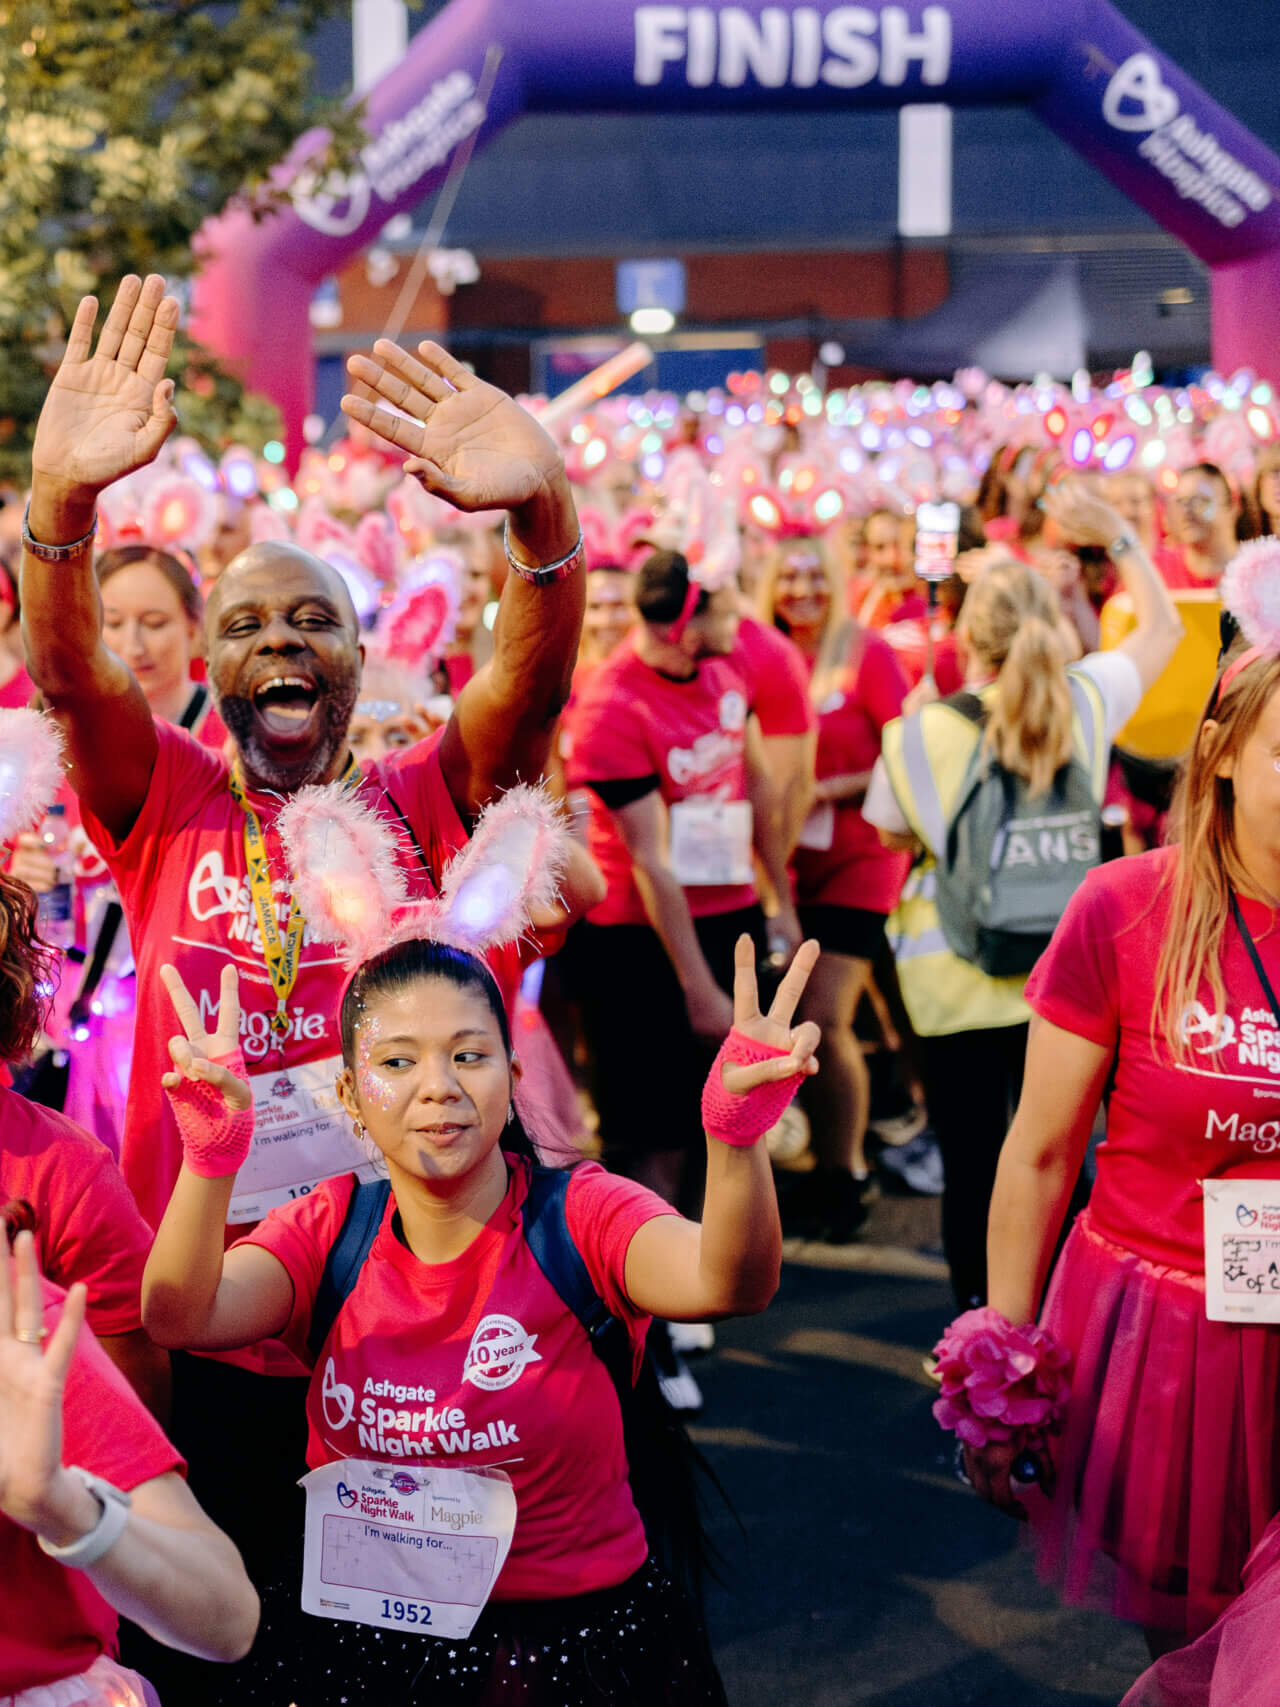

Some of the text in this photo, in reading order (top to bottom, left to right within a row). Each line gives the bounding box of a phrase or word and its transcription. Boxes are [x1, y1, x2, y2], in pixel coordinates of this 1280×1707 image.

[634, 6, 951, 88] FINISH
[258, 896, 276, 945] JAMAICA
[469, 1342, 524, 1368] 10 years
[363, 1377, 435, 1402] Ashgate
[361, 1398, 466, 1433] Sparkle
[358, 1420, 520, 1457] Night Walk
[360, 1503, 414, 1522] Night Walk
[361, 1492, 399, 1509] Sparkle
[431, 1505, 483, 1530] Magpie
[364, 1525, 452, 1551] I'm walking for...
[381, 1599, 432, 1625] 1952
